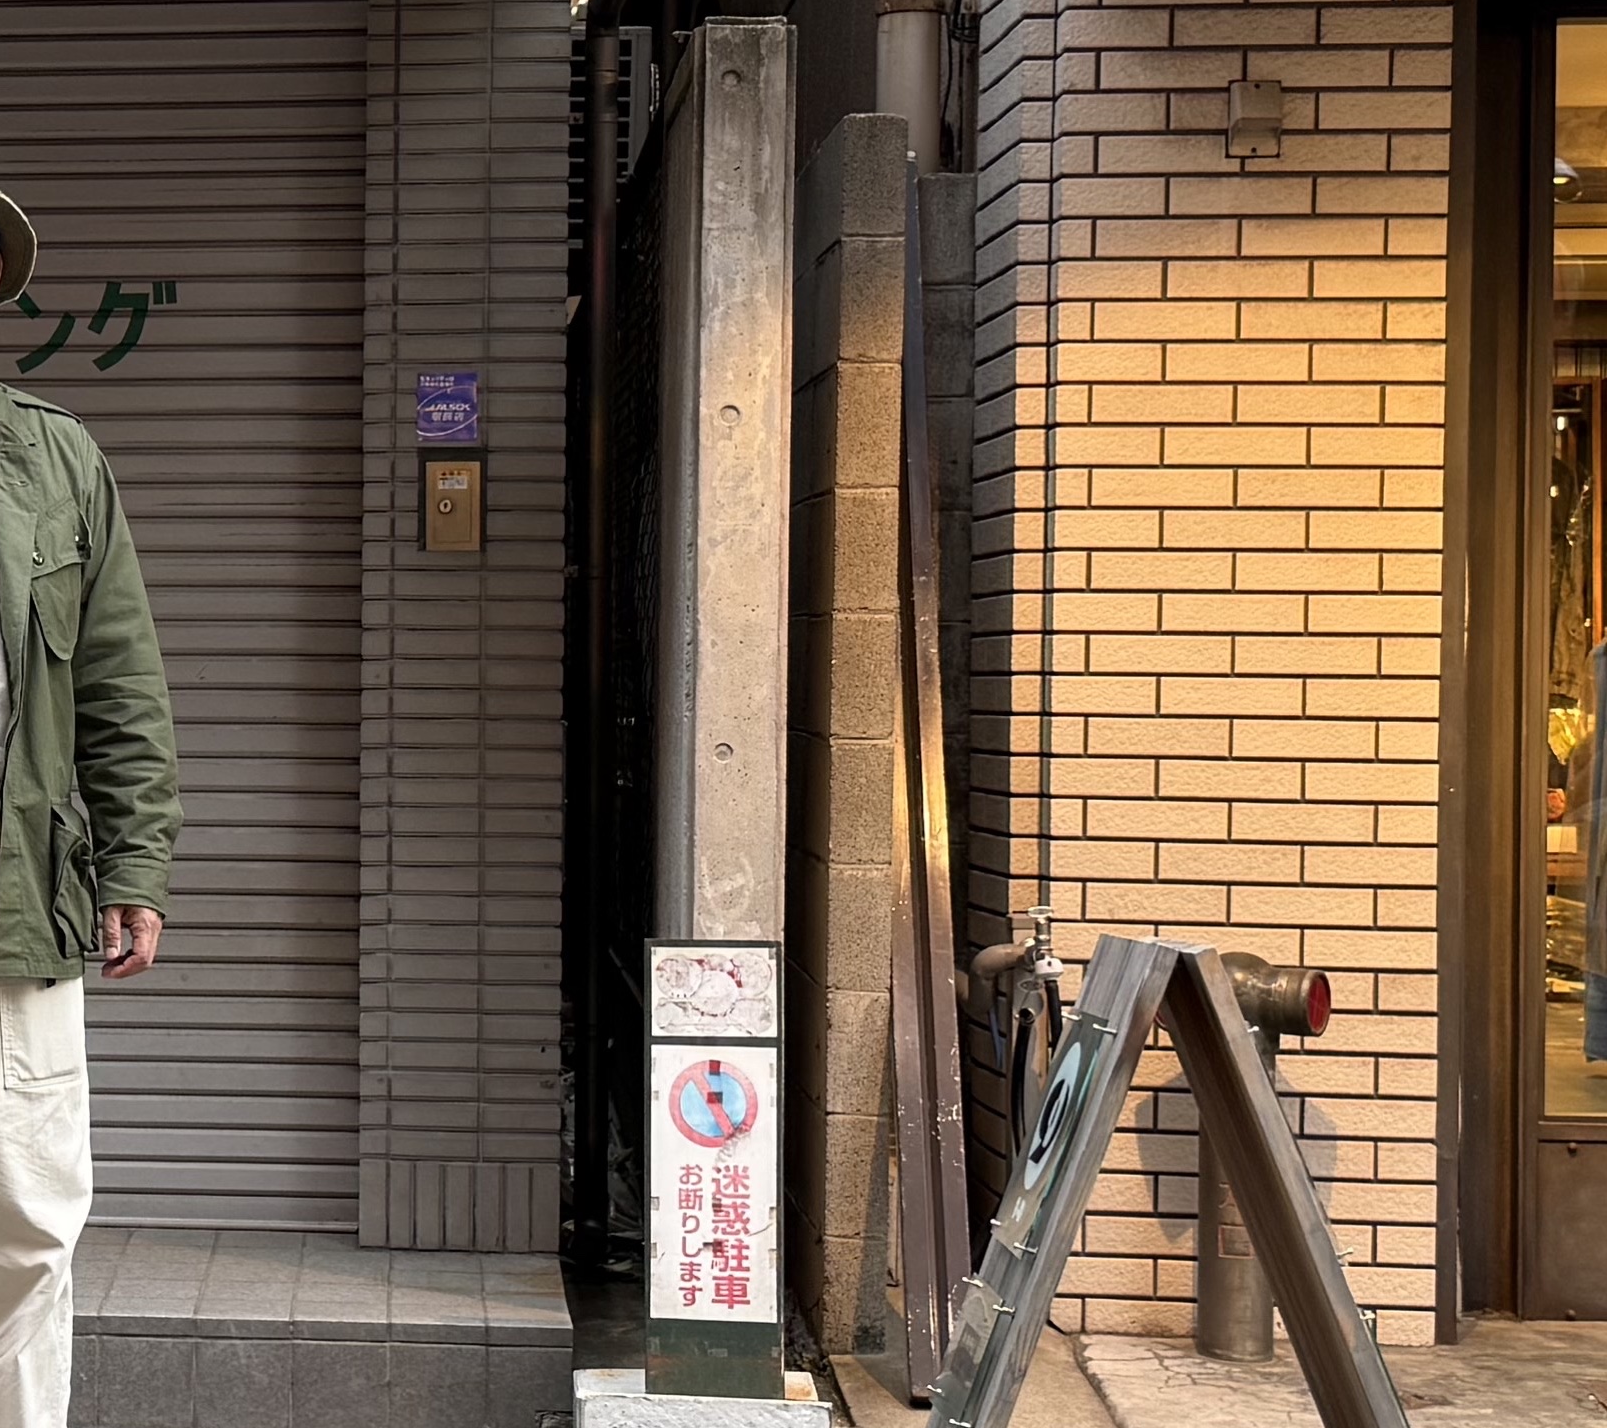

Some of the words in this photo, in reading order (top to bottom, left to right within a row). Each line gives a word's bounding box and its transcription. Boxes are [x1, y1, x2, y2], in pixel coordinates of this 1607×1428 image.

[678, 1163, 704, 1308] お断りします
[711, 1163, 751, 1311] 迷惑駐車
